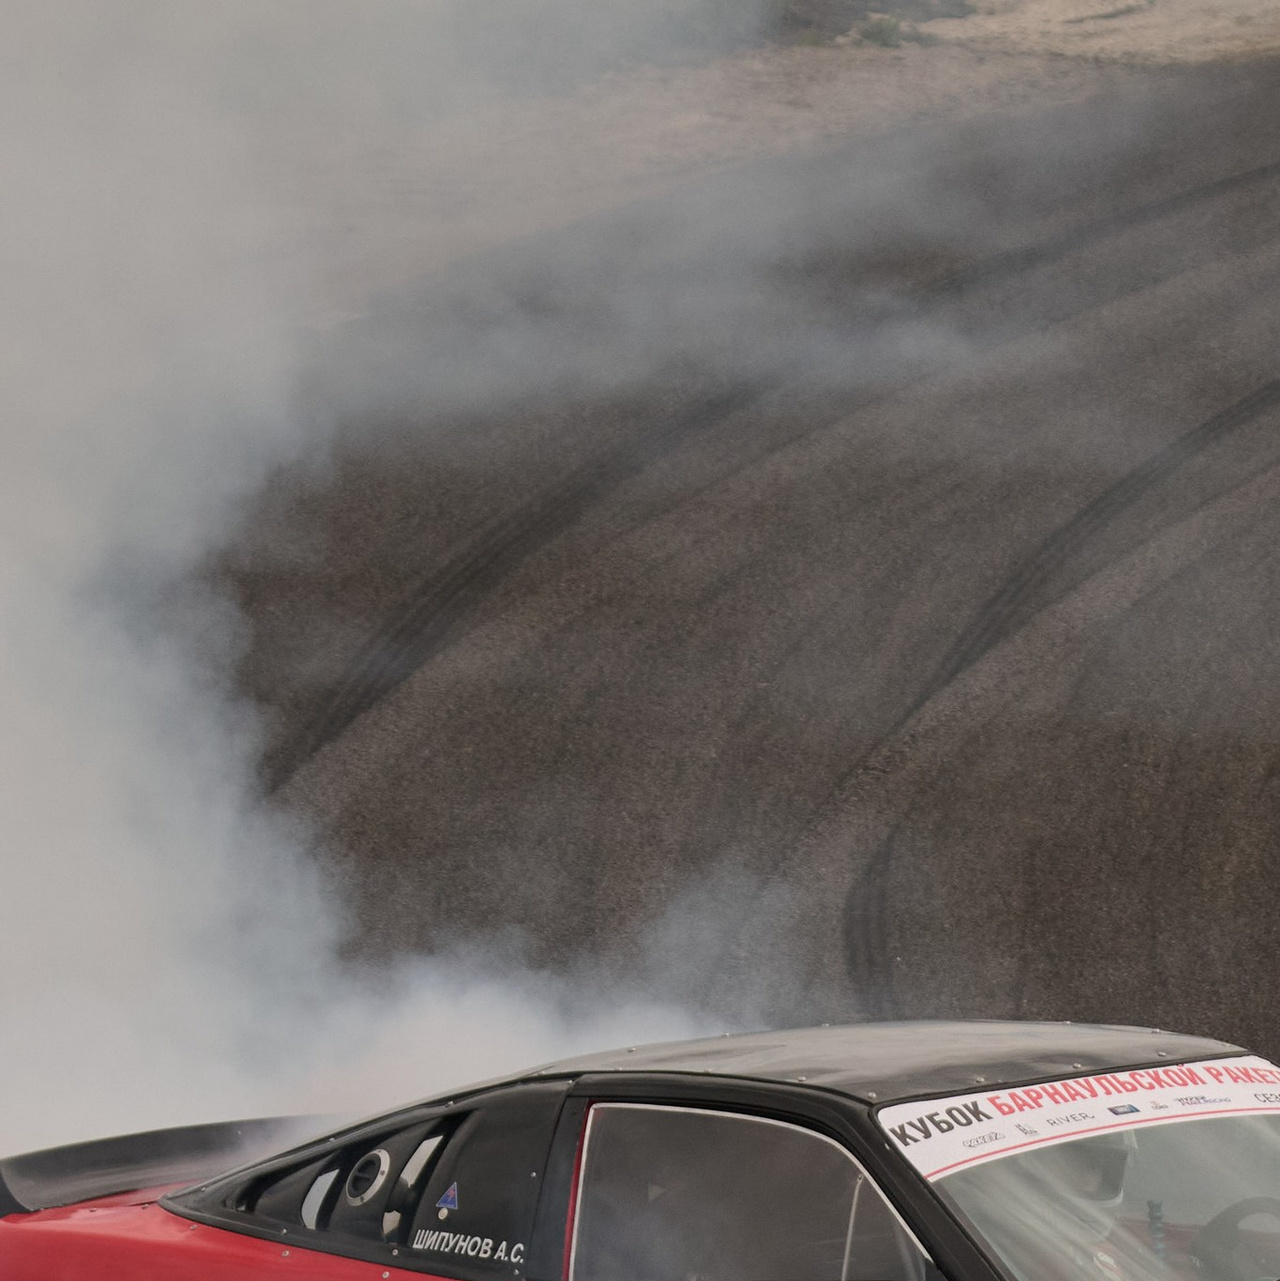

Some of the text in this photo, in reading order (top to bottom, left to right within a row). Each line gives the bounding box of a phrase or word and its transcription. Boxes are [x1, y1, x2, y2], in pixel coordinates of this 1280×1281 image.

[889, 1100, 993, 1147] КУБОК
[987, 1064, 1206, 1117] БАРНАУЛЬСКОЙ
[412, 1229, 525, 1263] ШИПУНОВ А.С.
